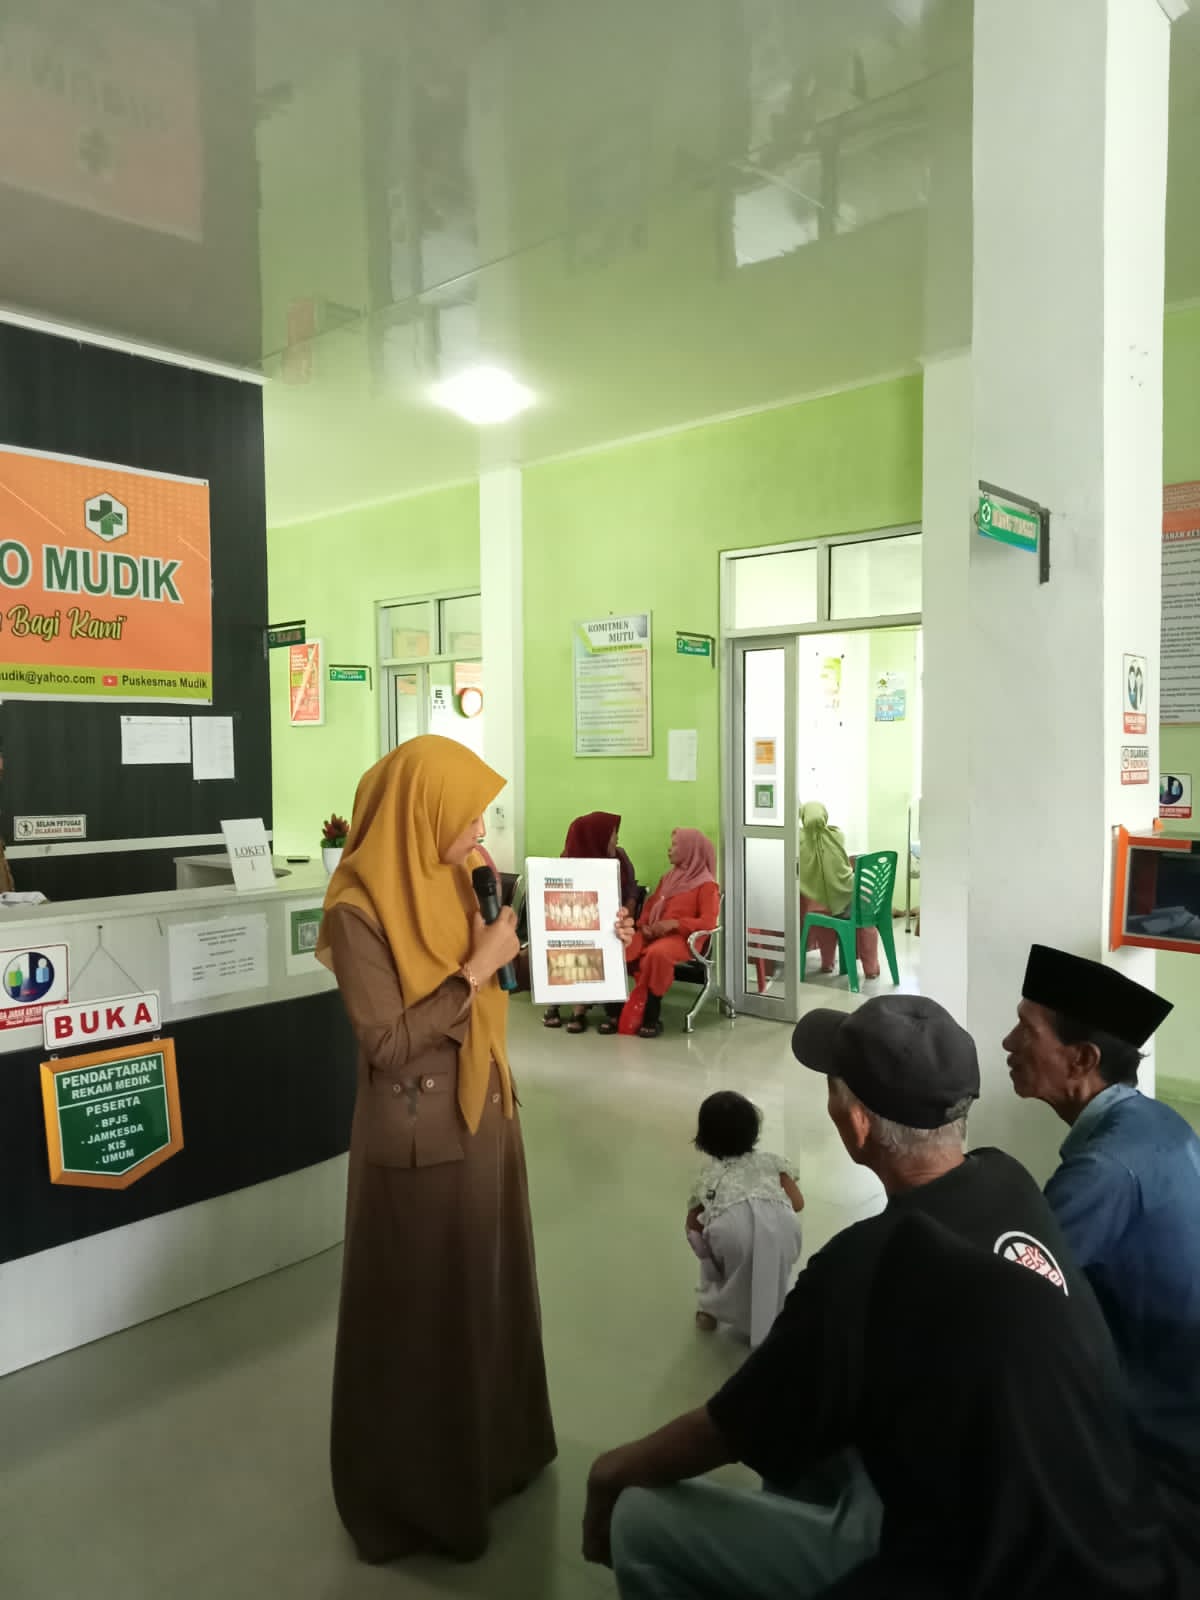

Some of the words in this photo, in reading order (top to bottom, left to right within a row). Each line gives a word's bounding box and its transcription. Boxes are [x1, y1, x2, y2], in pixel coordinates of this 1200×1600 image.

[43, 544, 184, 604] MUDIK
[7, 605, 61, 641] Bagi
[588, 621, 629, 633] KOMITMEN
[609, 632, 634, 642] MUTU
[122, 675, 177, 688] Puskesmas
[179, 677, 208, 689] Mudik
[435, 689, 443, 699] E
[233, 845, 266, 858] LOKET
[54, 1002, 152, 1040] BUKA
[62, 1059, 158, 1089] PENDAFTARAN
[71, 1082, 113, 1100] REKAM
[115, 1074, 150, 1091] MEDIK
[86, 1095, 141, 1116] PESERTA
[101, 1114, 129, 1128] BPJS
[87, 1124, 144, 1145] JAMKESDA
[101, 1148, 135, 1165] UMUM
[107, 1140, 127, 1152] KIS
